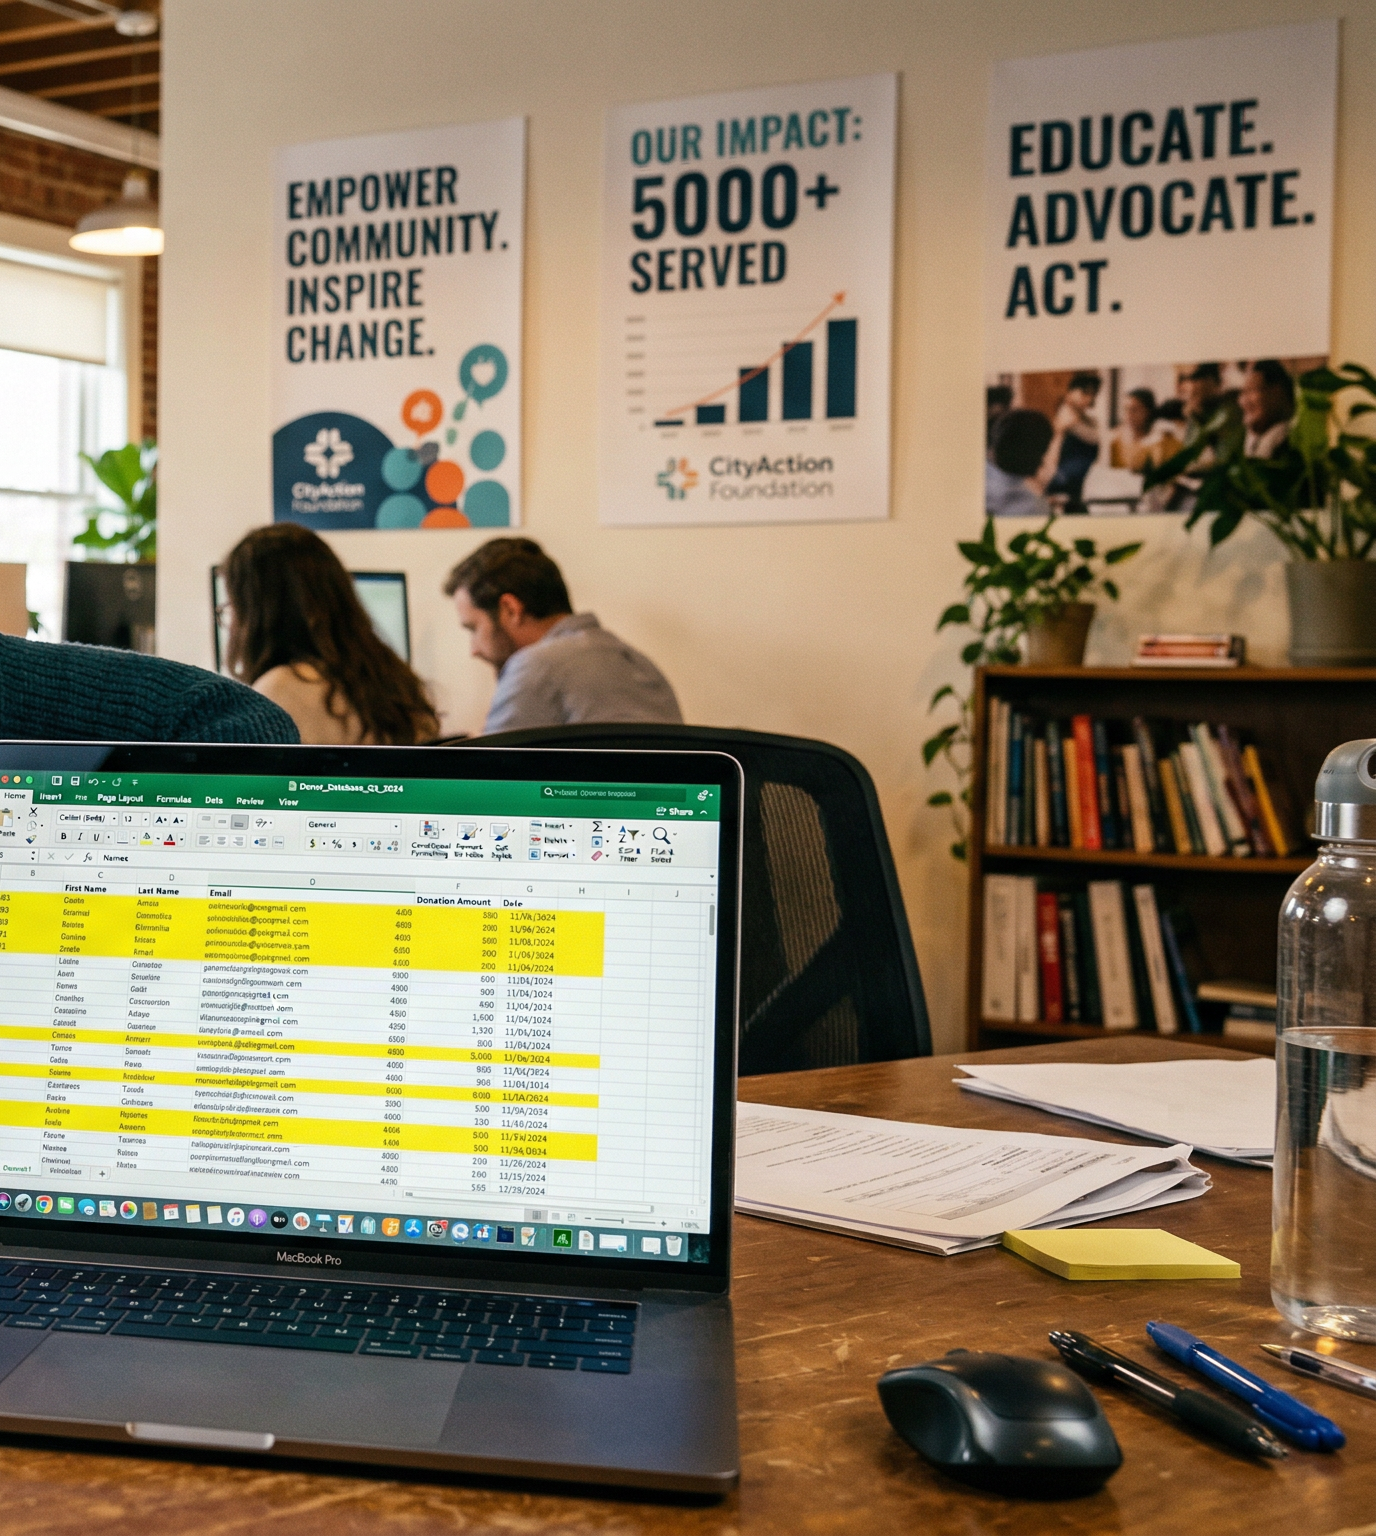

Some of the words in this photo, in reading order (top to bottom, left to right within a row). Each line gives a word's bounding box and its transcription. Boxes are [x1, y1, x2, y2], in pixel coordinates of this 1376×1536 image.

[630, 124, 703, 168] OUR
[717, 107, 863, 158] IMPACT:
[1009, 98, 1273, 178] EDUCATE.
[286, 164, 459, 220] EMPOWER
[631, 163, 840, 242] 5000+
[1005, 169, 1315, 249] ADVOCATE.
[286, 211, 508, 268] COMMUNITY.
[286, 268, 423, 317] INSPIRE
[630, 241, 787, 294] SERVED
[1005, 259, 1122, 319] ACT.
[286, 317, 435, 364] CHANGE.
[709, 454, 833, 479] CityAction
[709, 478, 833, 500] Foundation
[457, 898, 490, 906] Amount
[276, 1251, 323, 1265] MacBook
[324, 1254, 342, 1266] Pro
